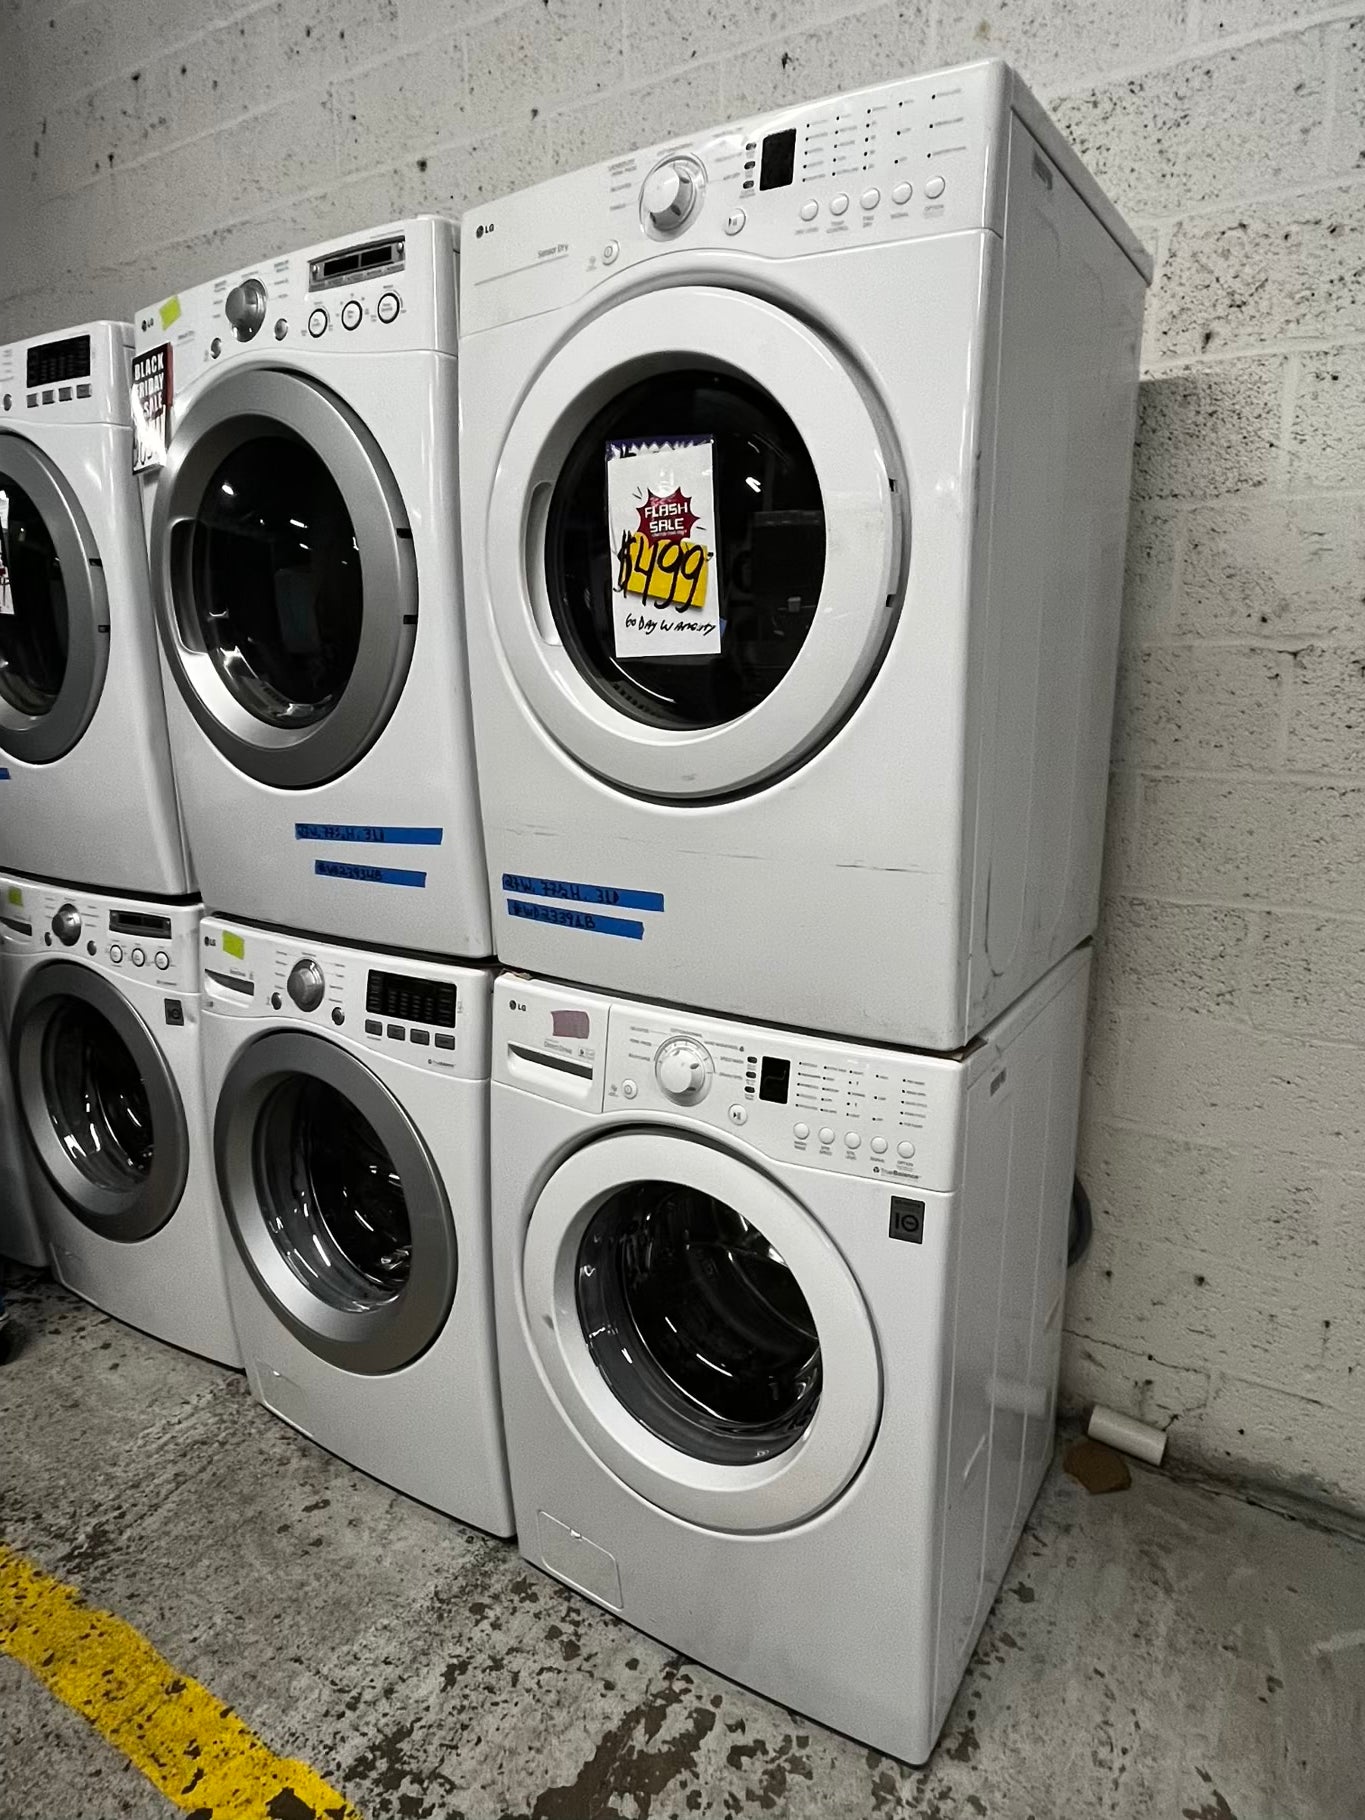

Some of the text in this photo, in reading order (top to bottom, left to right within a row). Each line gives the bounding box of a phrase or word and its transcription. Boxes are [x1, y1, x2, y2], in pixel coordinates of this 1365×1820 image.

[485, 223, 495, 234] LG
[134, 352, 164, 381] BLACK
[138, 372, 164, 400] RIDAY
[644, 501, 688, 519] FLASH
[649, 517, 685, 533] SALE
[518, 1003, 527, 1012] LG
